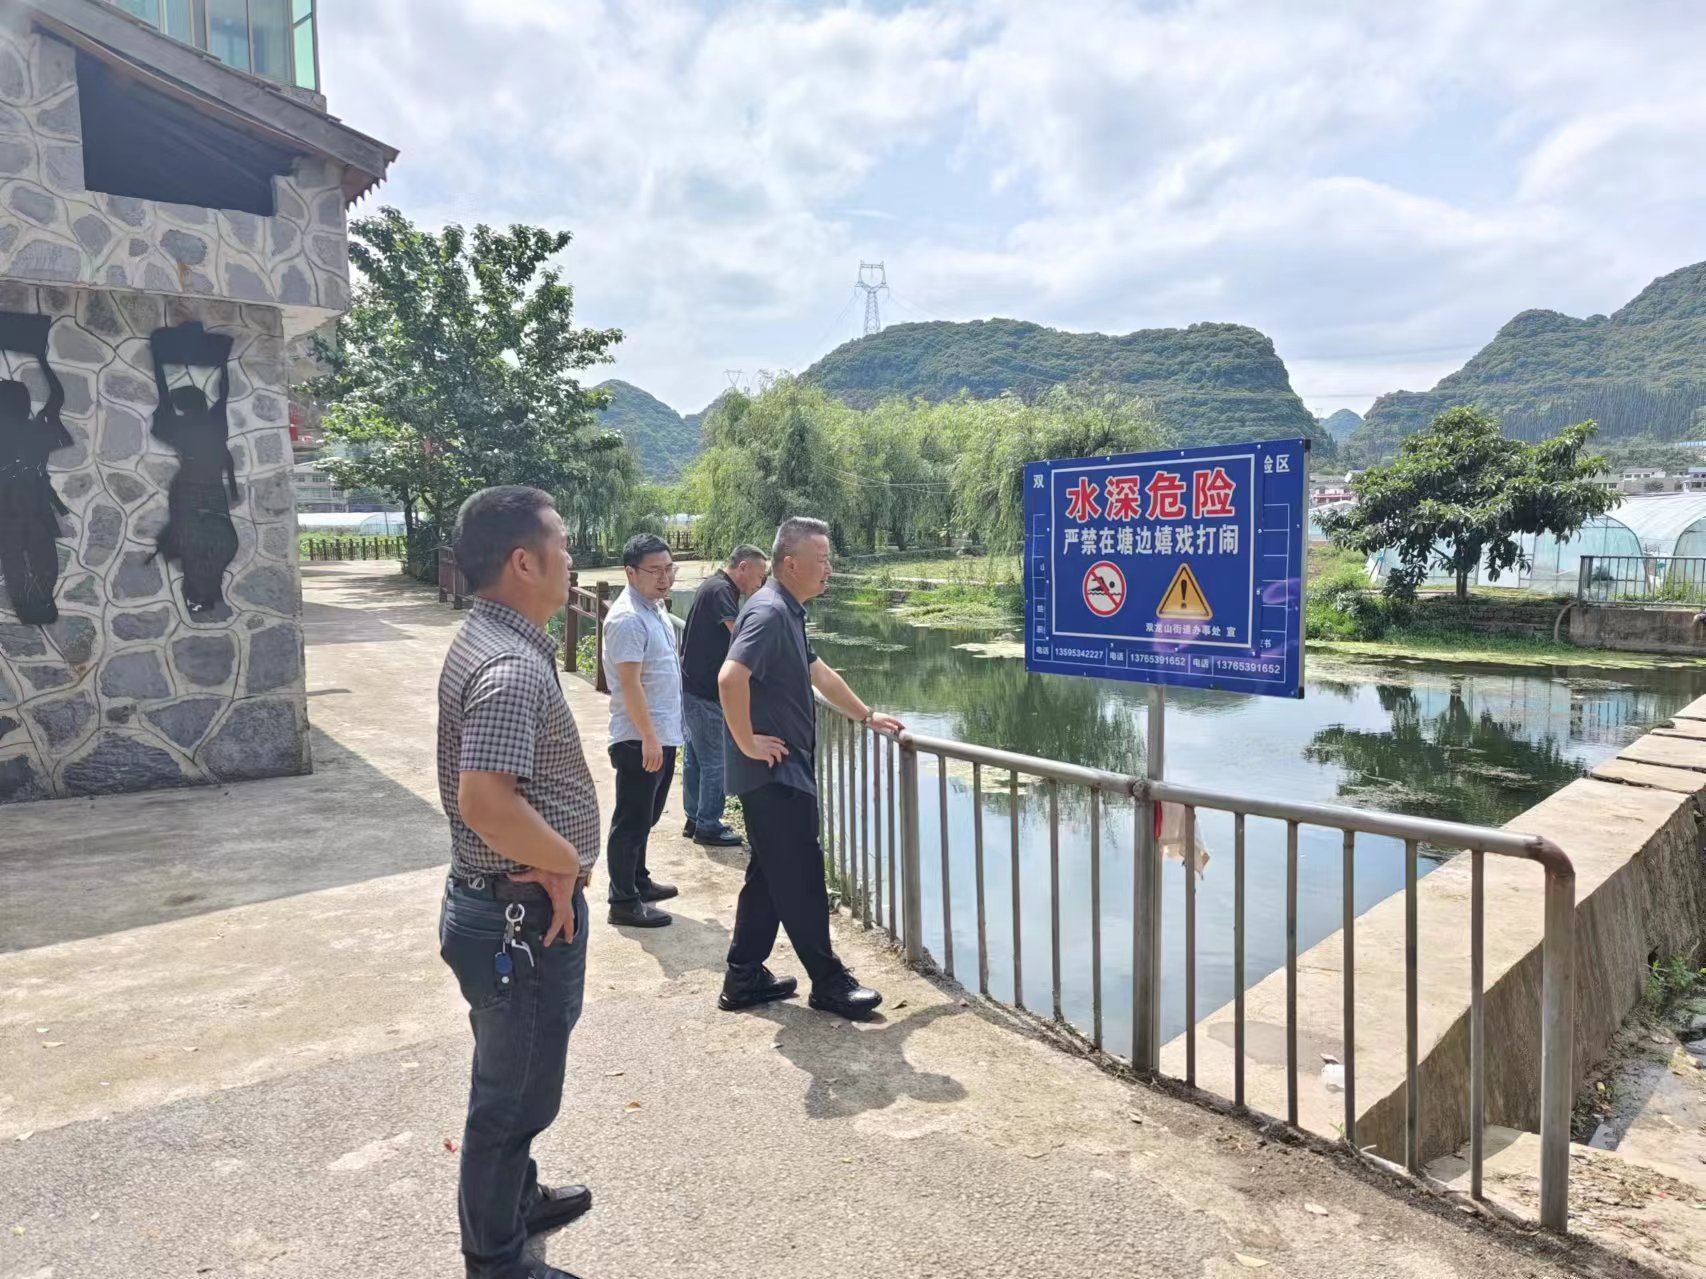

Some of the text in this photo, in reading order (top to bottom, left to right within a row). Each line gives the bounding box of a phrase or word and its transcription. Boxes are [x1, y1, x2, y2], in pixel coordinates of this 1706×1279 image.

[1065, 467, 1236, 522] 水深危险
[1063, 524, 1239, 555] 严禁在塘边嬉戏打闹
[1130, 654, 1186, 667] 13765391652
[1216, 660, 1281, 674] 13765391652
